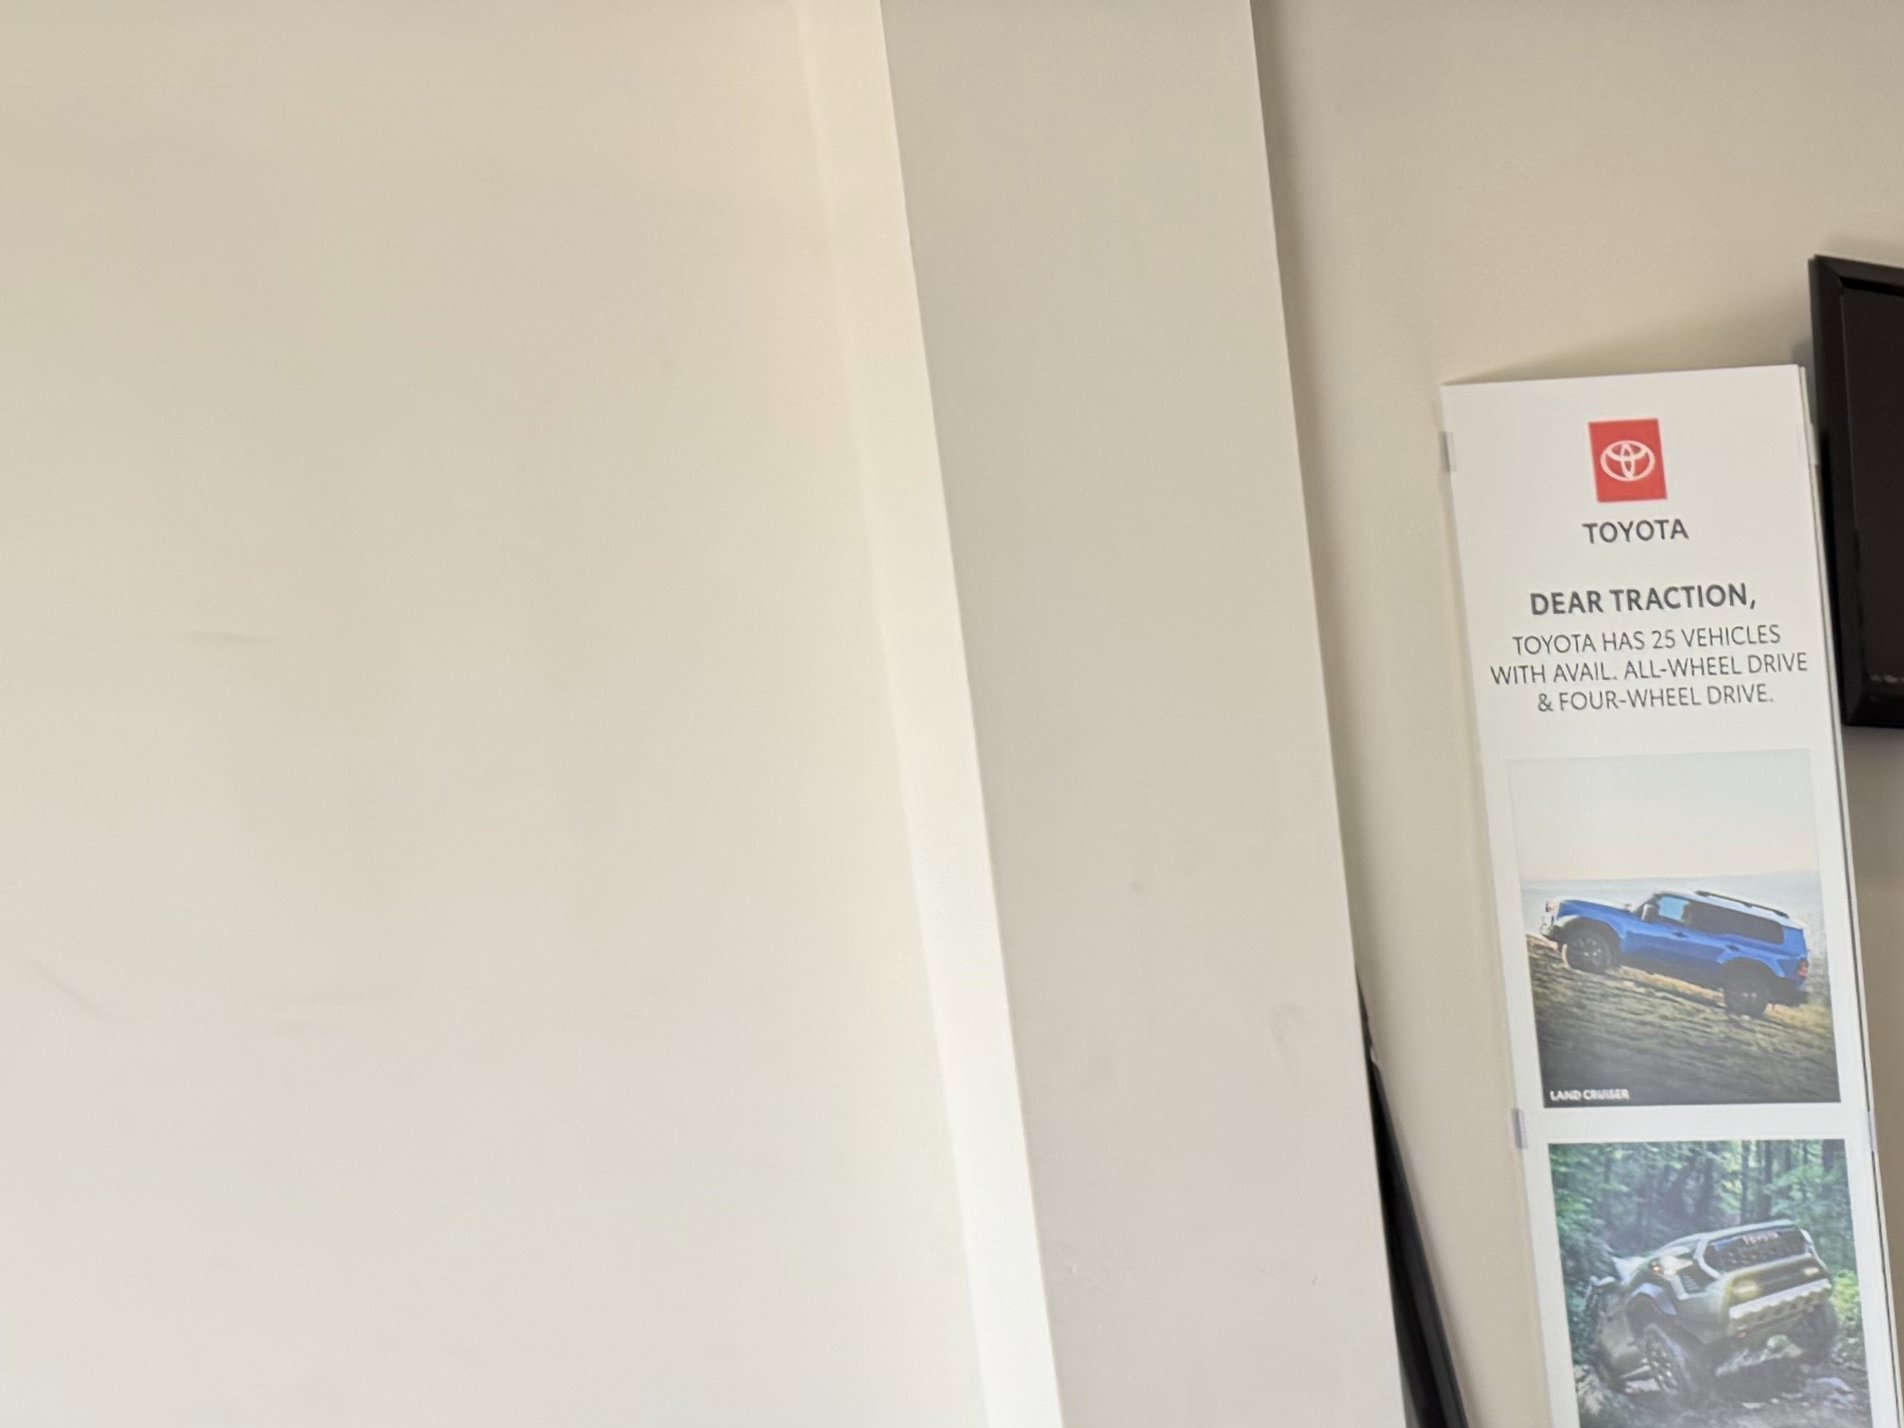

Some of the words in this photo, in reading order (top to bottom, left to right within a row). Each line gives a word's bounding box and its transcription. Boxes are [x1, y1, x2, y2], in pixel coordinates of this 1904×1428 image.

[1583, 519, 1689, 544] TOYOTA
[1530, 590, 1604, 615] DEAR
[1611, 582, 1756, 612] TRACTION,
[1512, 633, 1596, 655] TOYOTA
[1602, 631, 1645, 652] HAS
[1651, 629, 1676, 649] 25
[1682, 624, 1781, 647] VEHICLES
[1490, 664, 1546, 686] WITH
[1552, 661, 1618, 683] AVAIL.
[1624, 656, 1741, 679] ALL-WHEEL
[1747, 652, 1808, 674] DRIVE
[1537, 692, 1553, 712] &
[1559, 687, 1701, 711] FOUR-WHEEL
[1706, 684, 1774, 706] DRIVE.
